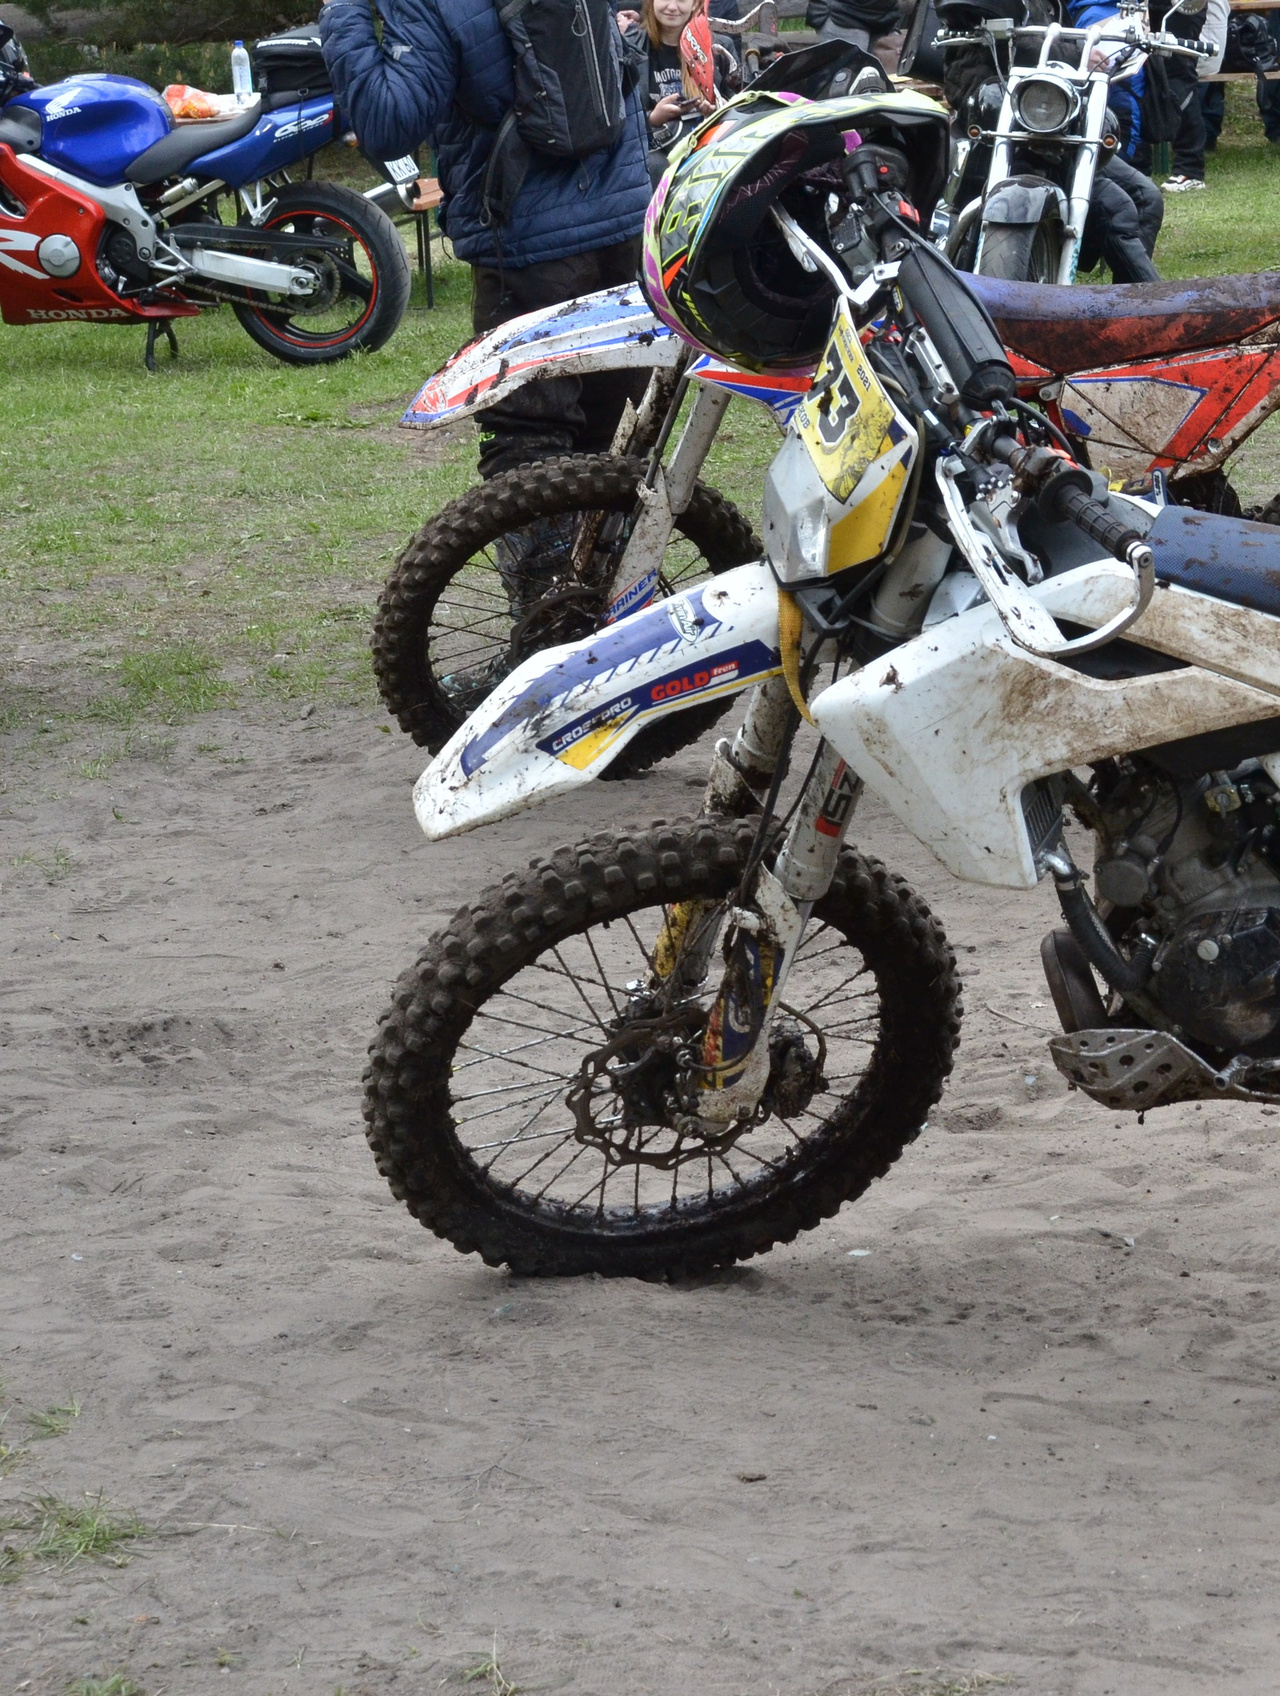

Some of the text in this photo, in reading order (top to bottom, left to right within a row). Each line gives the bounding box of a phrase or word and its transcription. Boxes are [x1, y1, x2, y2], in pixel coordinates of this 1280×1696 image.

[46, 106, 82, 122] HONDA
[26, 308, 131, 320] HONDA
[856, 363, 872, 393] 2021
[650, 663, 737, 702] GOLD fren
[552, 696, 632, 751] CROSPRO
